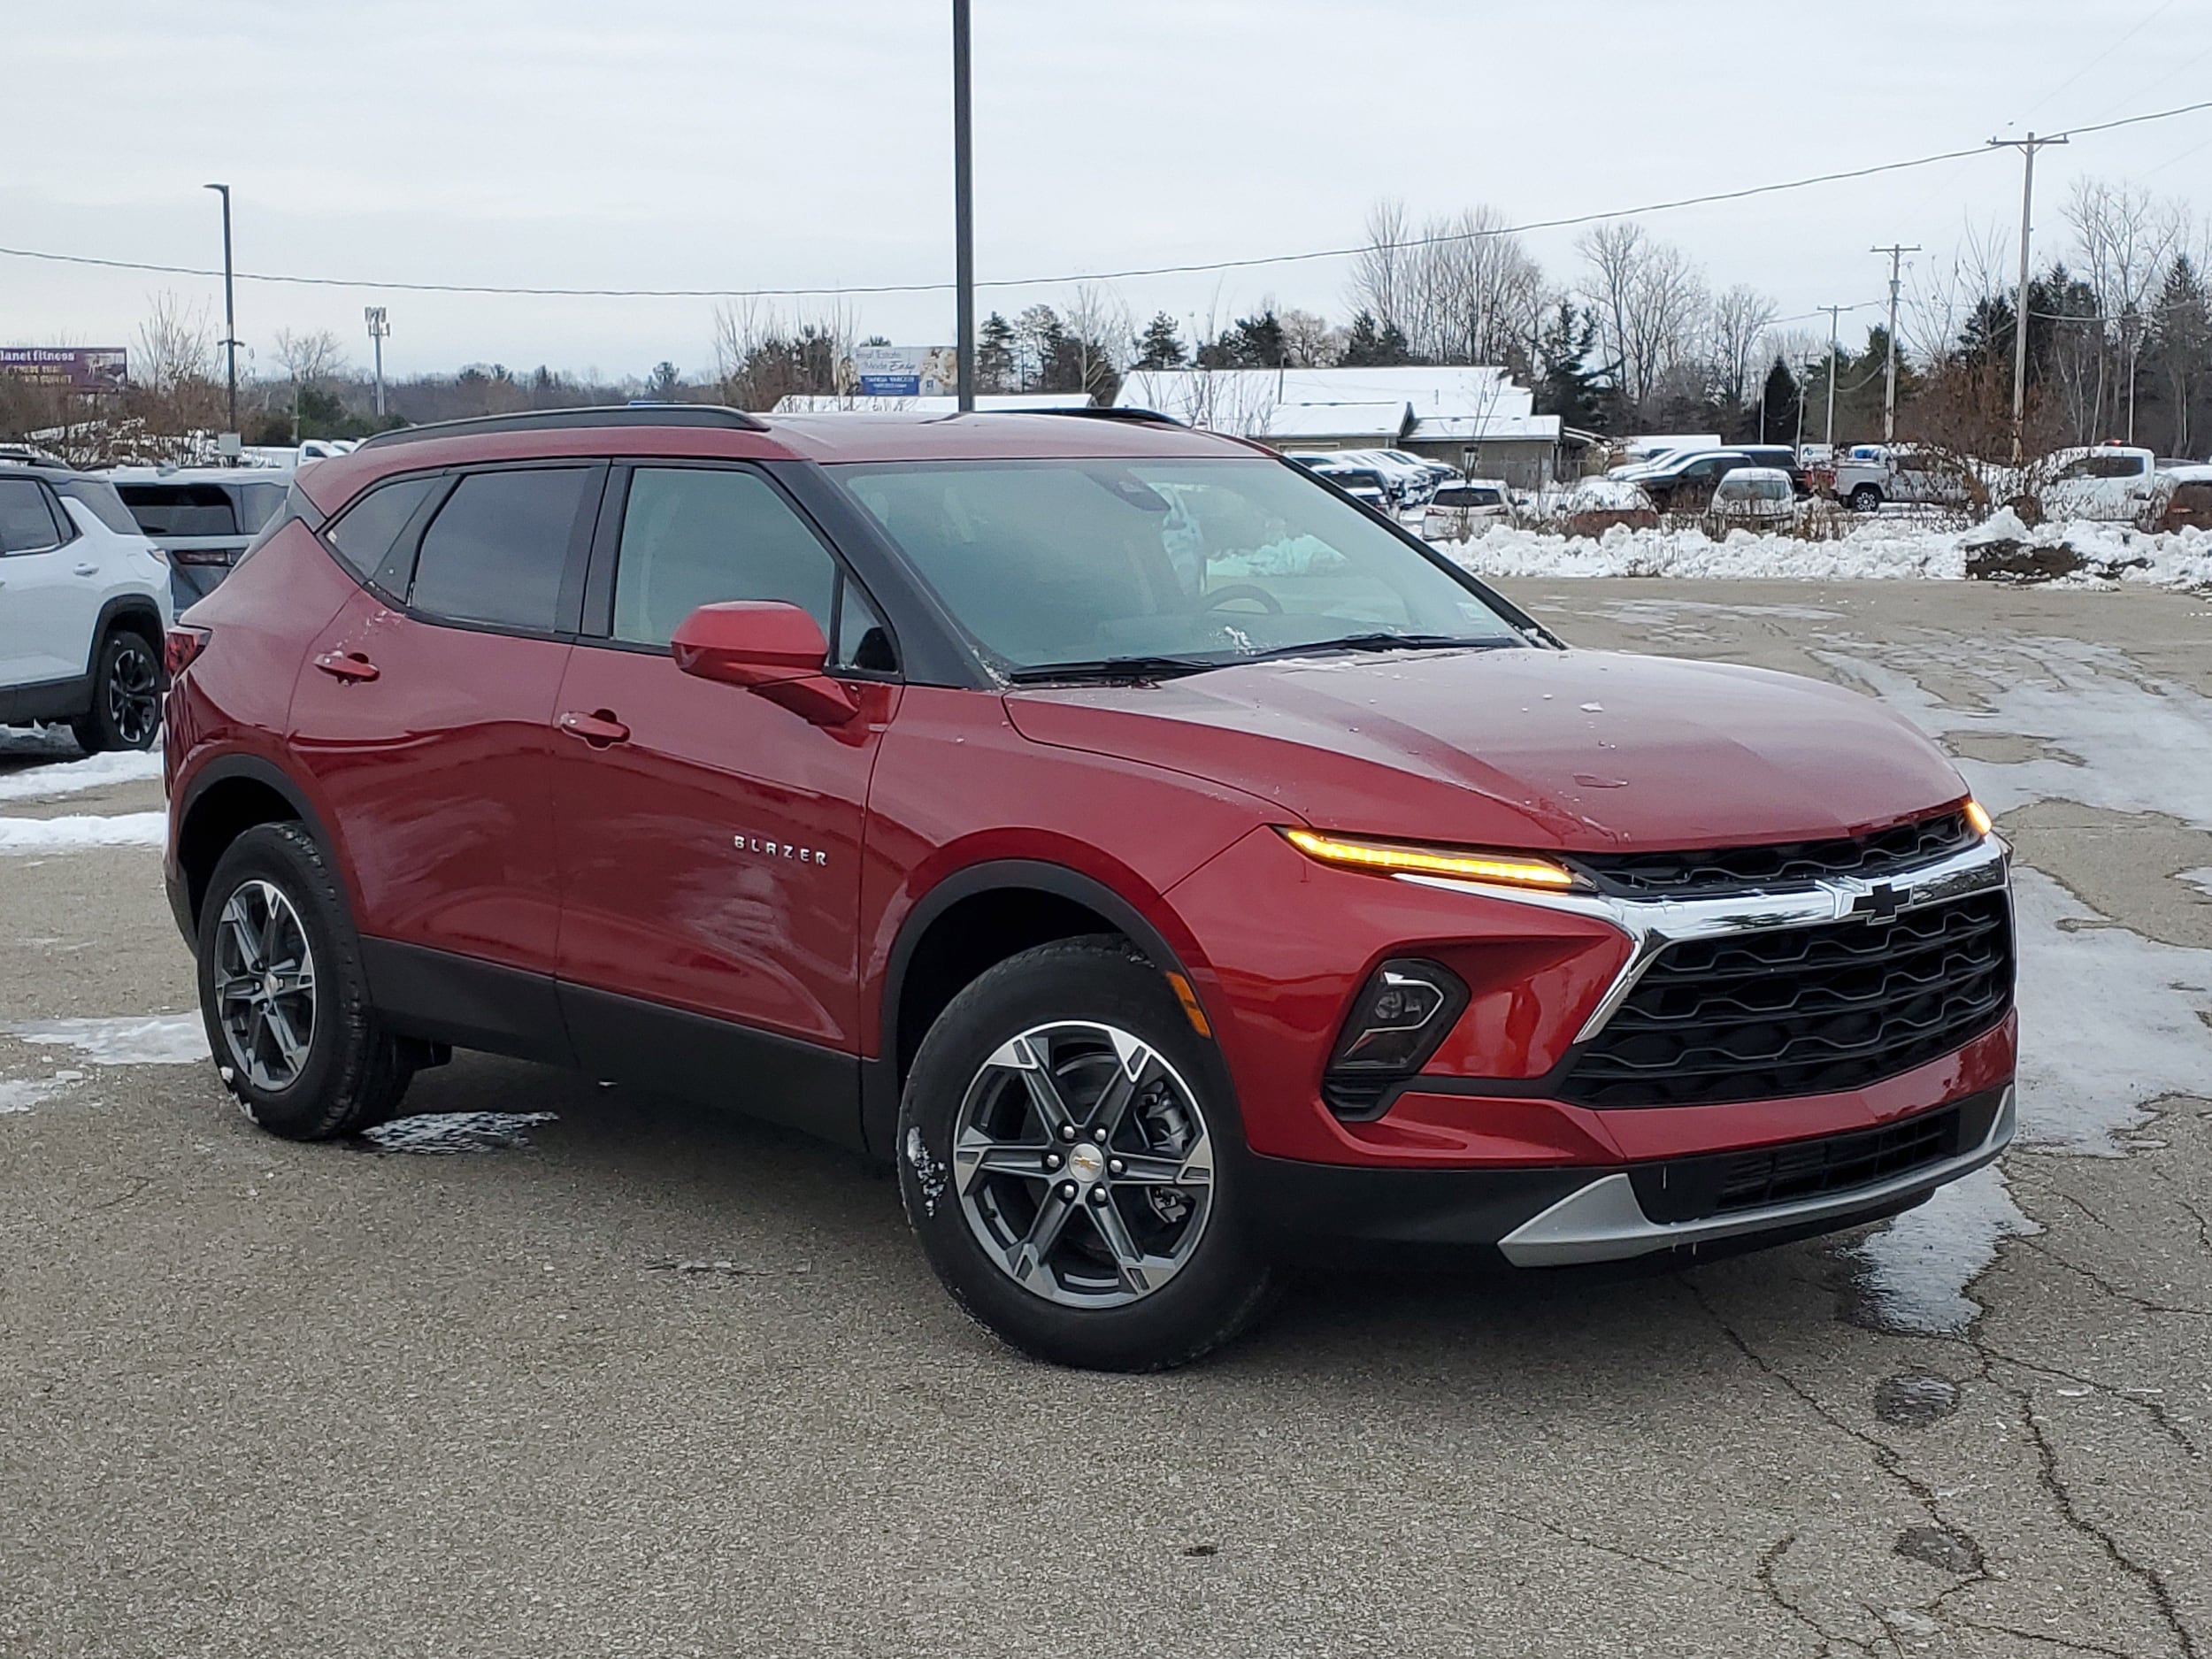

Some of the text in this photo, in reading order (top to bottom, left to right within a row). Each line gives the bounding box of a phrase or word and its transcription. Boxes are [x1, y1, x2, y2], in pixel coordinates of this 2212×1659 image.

[0, 349, 74, 361] lanet fitness
[733, 834, 827, 866] BLAZER
